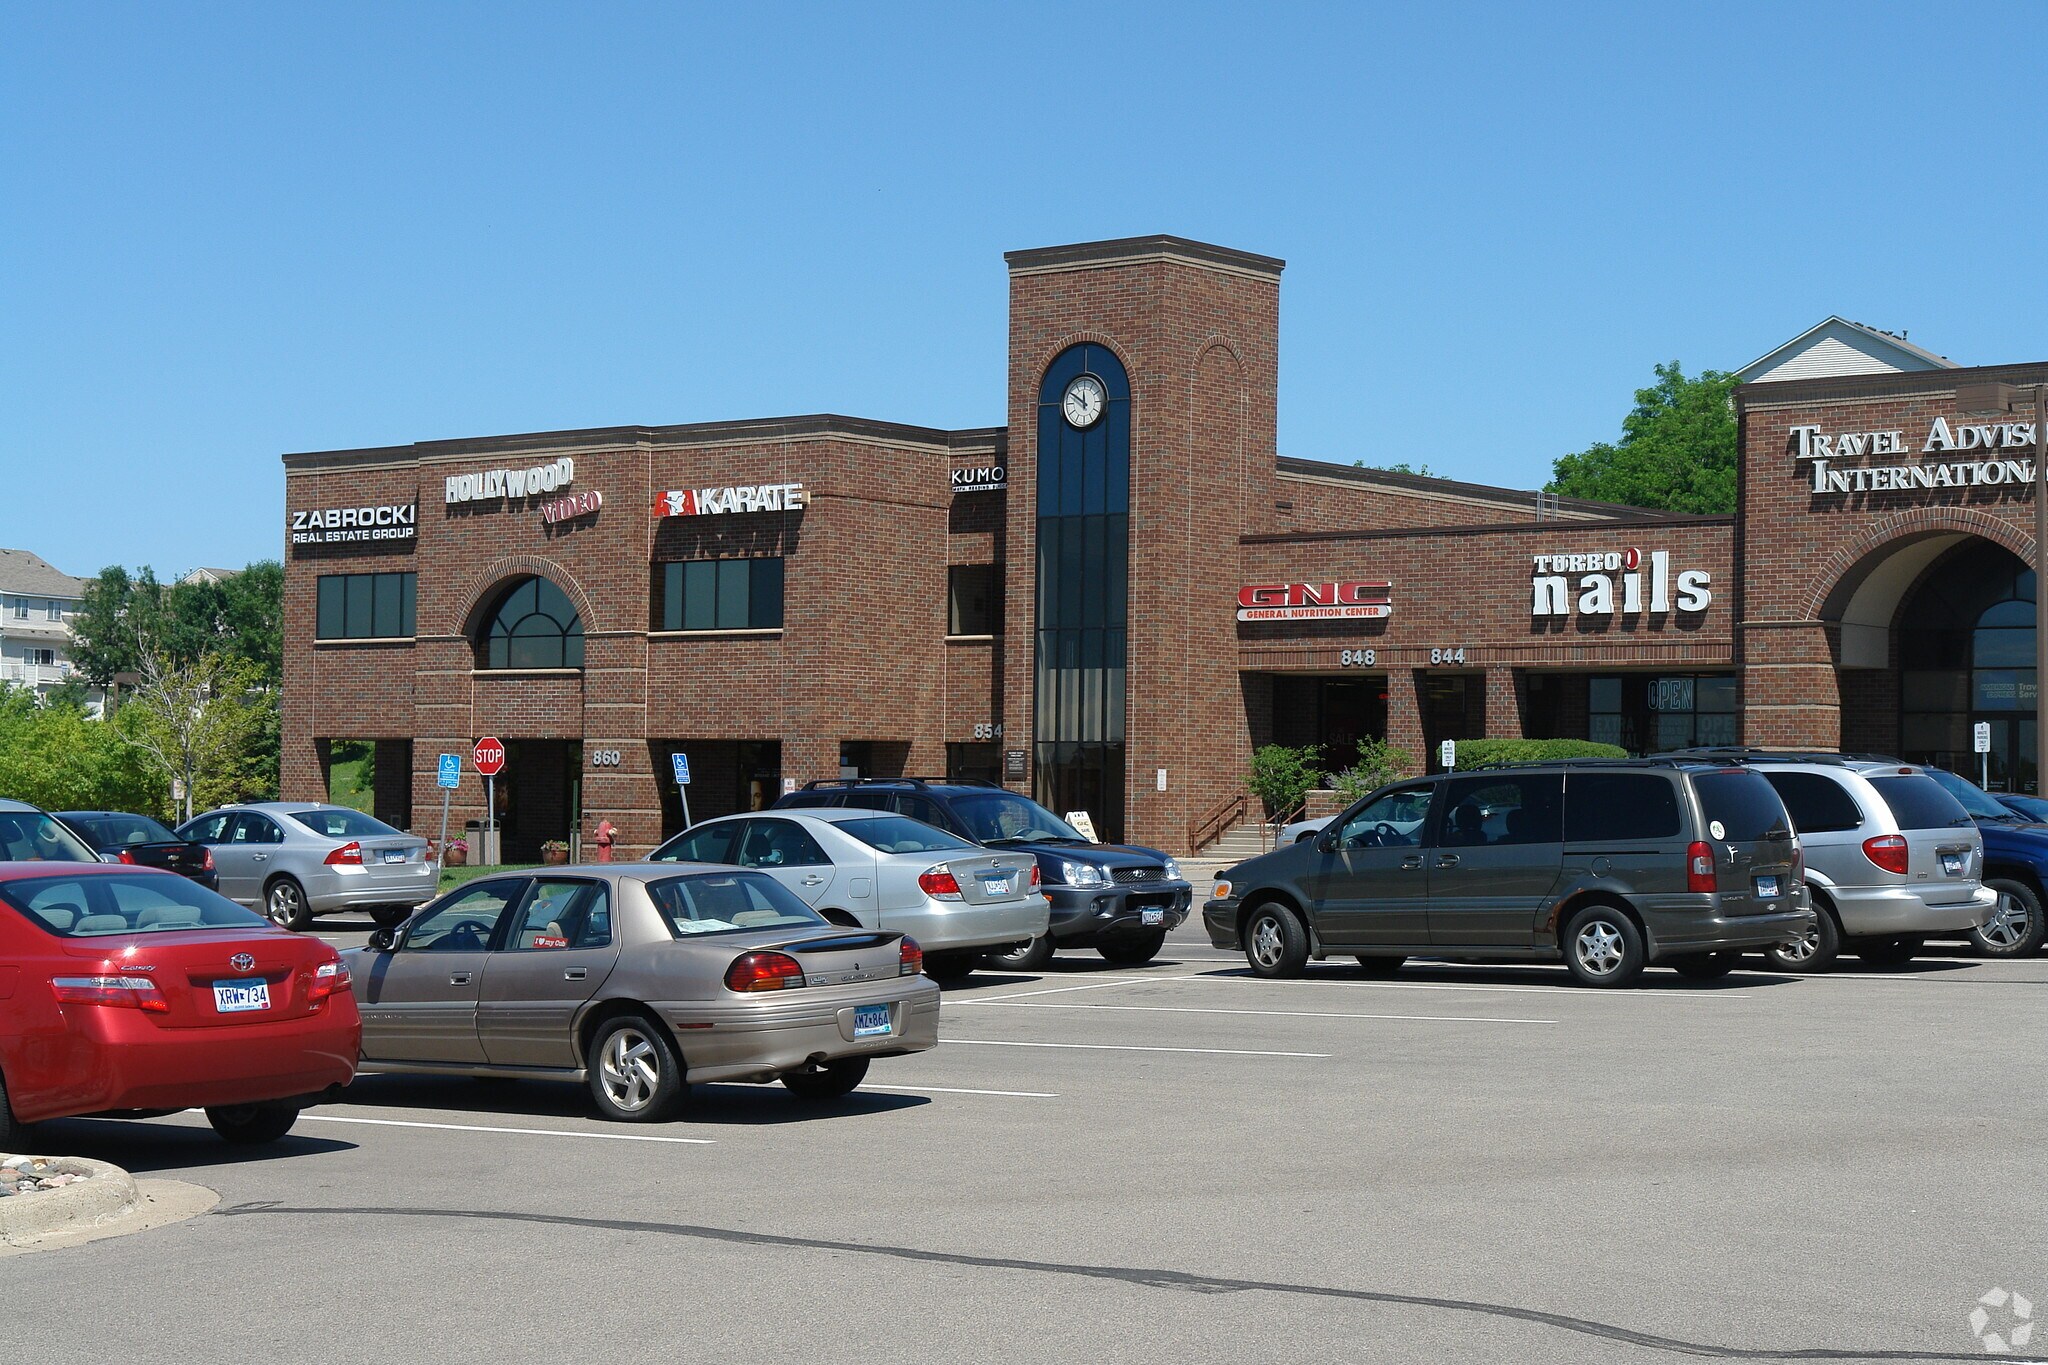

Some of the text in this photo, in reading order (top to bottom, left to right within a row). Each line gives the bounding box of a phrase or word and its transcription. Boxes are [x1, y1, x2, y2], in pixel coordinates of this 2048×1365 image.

[1790, 424, 1909, 459] TRAVEL
[446, 457, 574, 504] HOLLYWOOD
[541, 490, 602, 524] VIDEO
[701, 483, 803, 515] KARATE
[292, 504, 416, 530] ZABROCKI
[292, 527, 414, 544] REAL ESTATE GROUP
[1533, 552, 1622, 573] TURBO
[1532, 549, 1712, 616] nails
[1238, 581, 1392, 607] GNC
[1246, 607, 1379, 619] GENERAL NUTRITION CENTER
[1341, 649, 1376, 666] 848
[1430, 648, 1465, 665] 844
[1647, 680, 1694, 710] OPEN
[974, 723, 1003, 738] 854
[476, 749, 502, 763] STOP
[593, 750, 620, 765] 860
[218, 986, 267, 1005] XRW 734
[873, 1011, 889, 1027] 864
